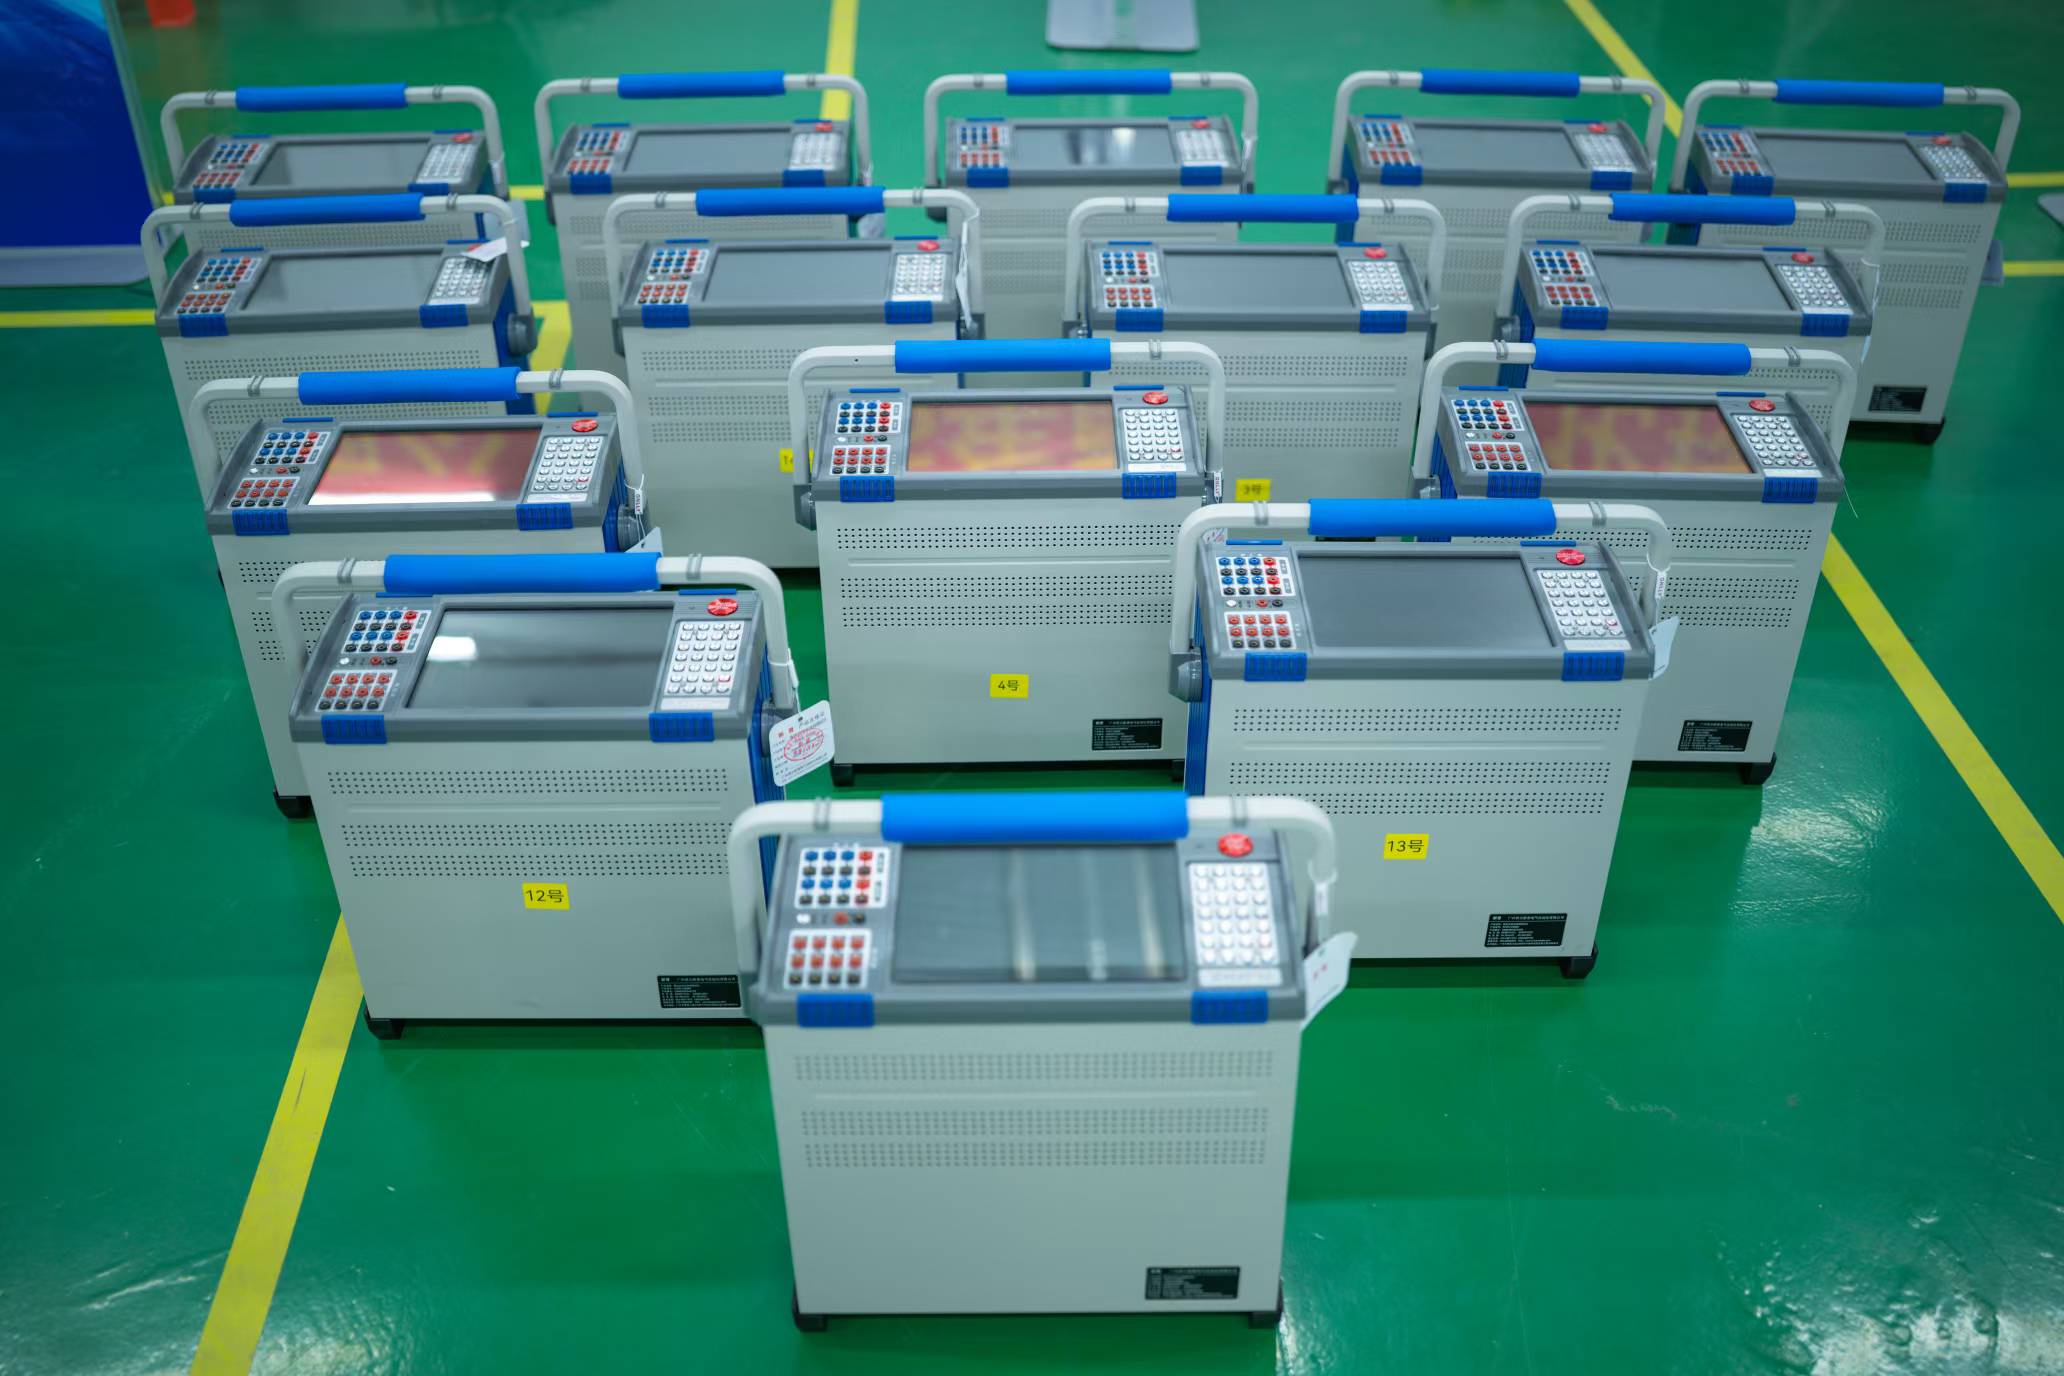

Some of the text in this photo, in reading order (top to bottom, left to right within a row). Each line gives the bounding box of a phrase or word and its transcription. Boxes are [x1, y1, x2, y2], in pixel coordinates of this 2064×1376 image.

[997, 679, 1020, 692] 4号
[1387, 839, 1425, 853] 13号
[525, 889, 565, 903] 12号
